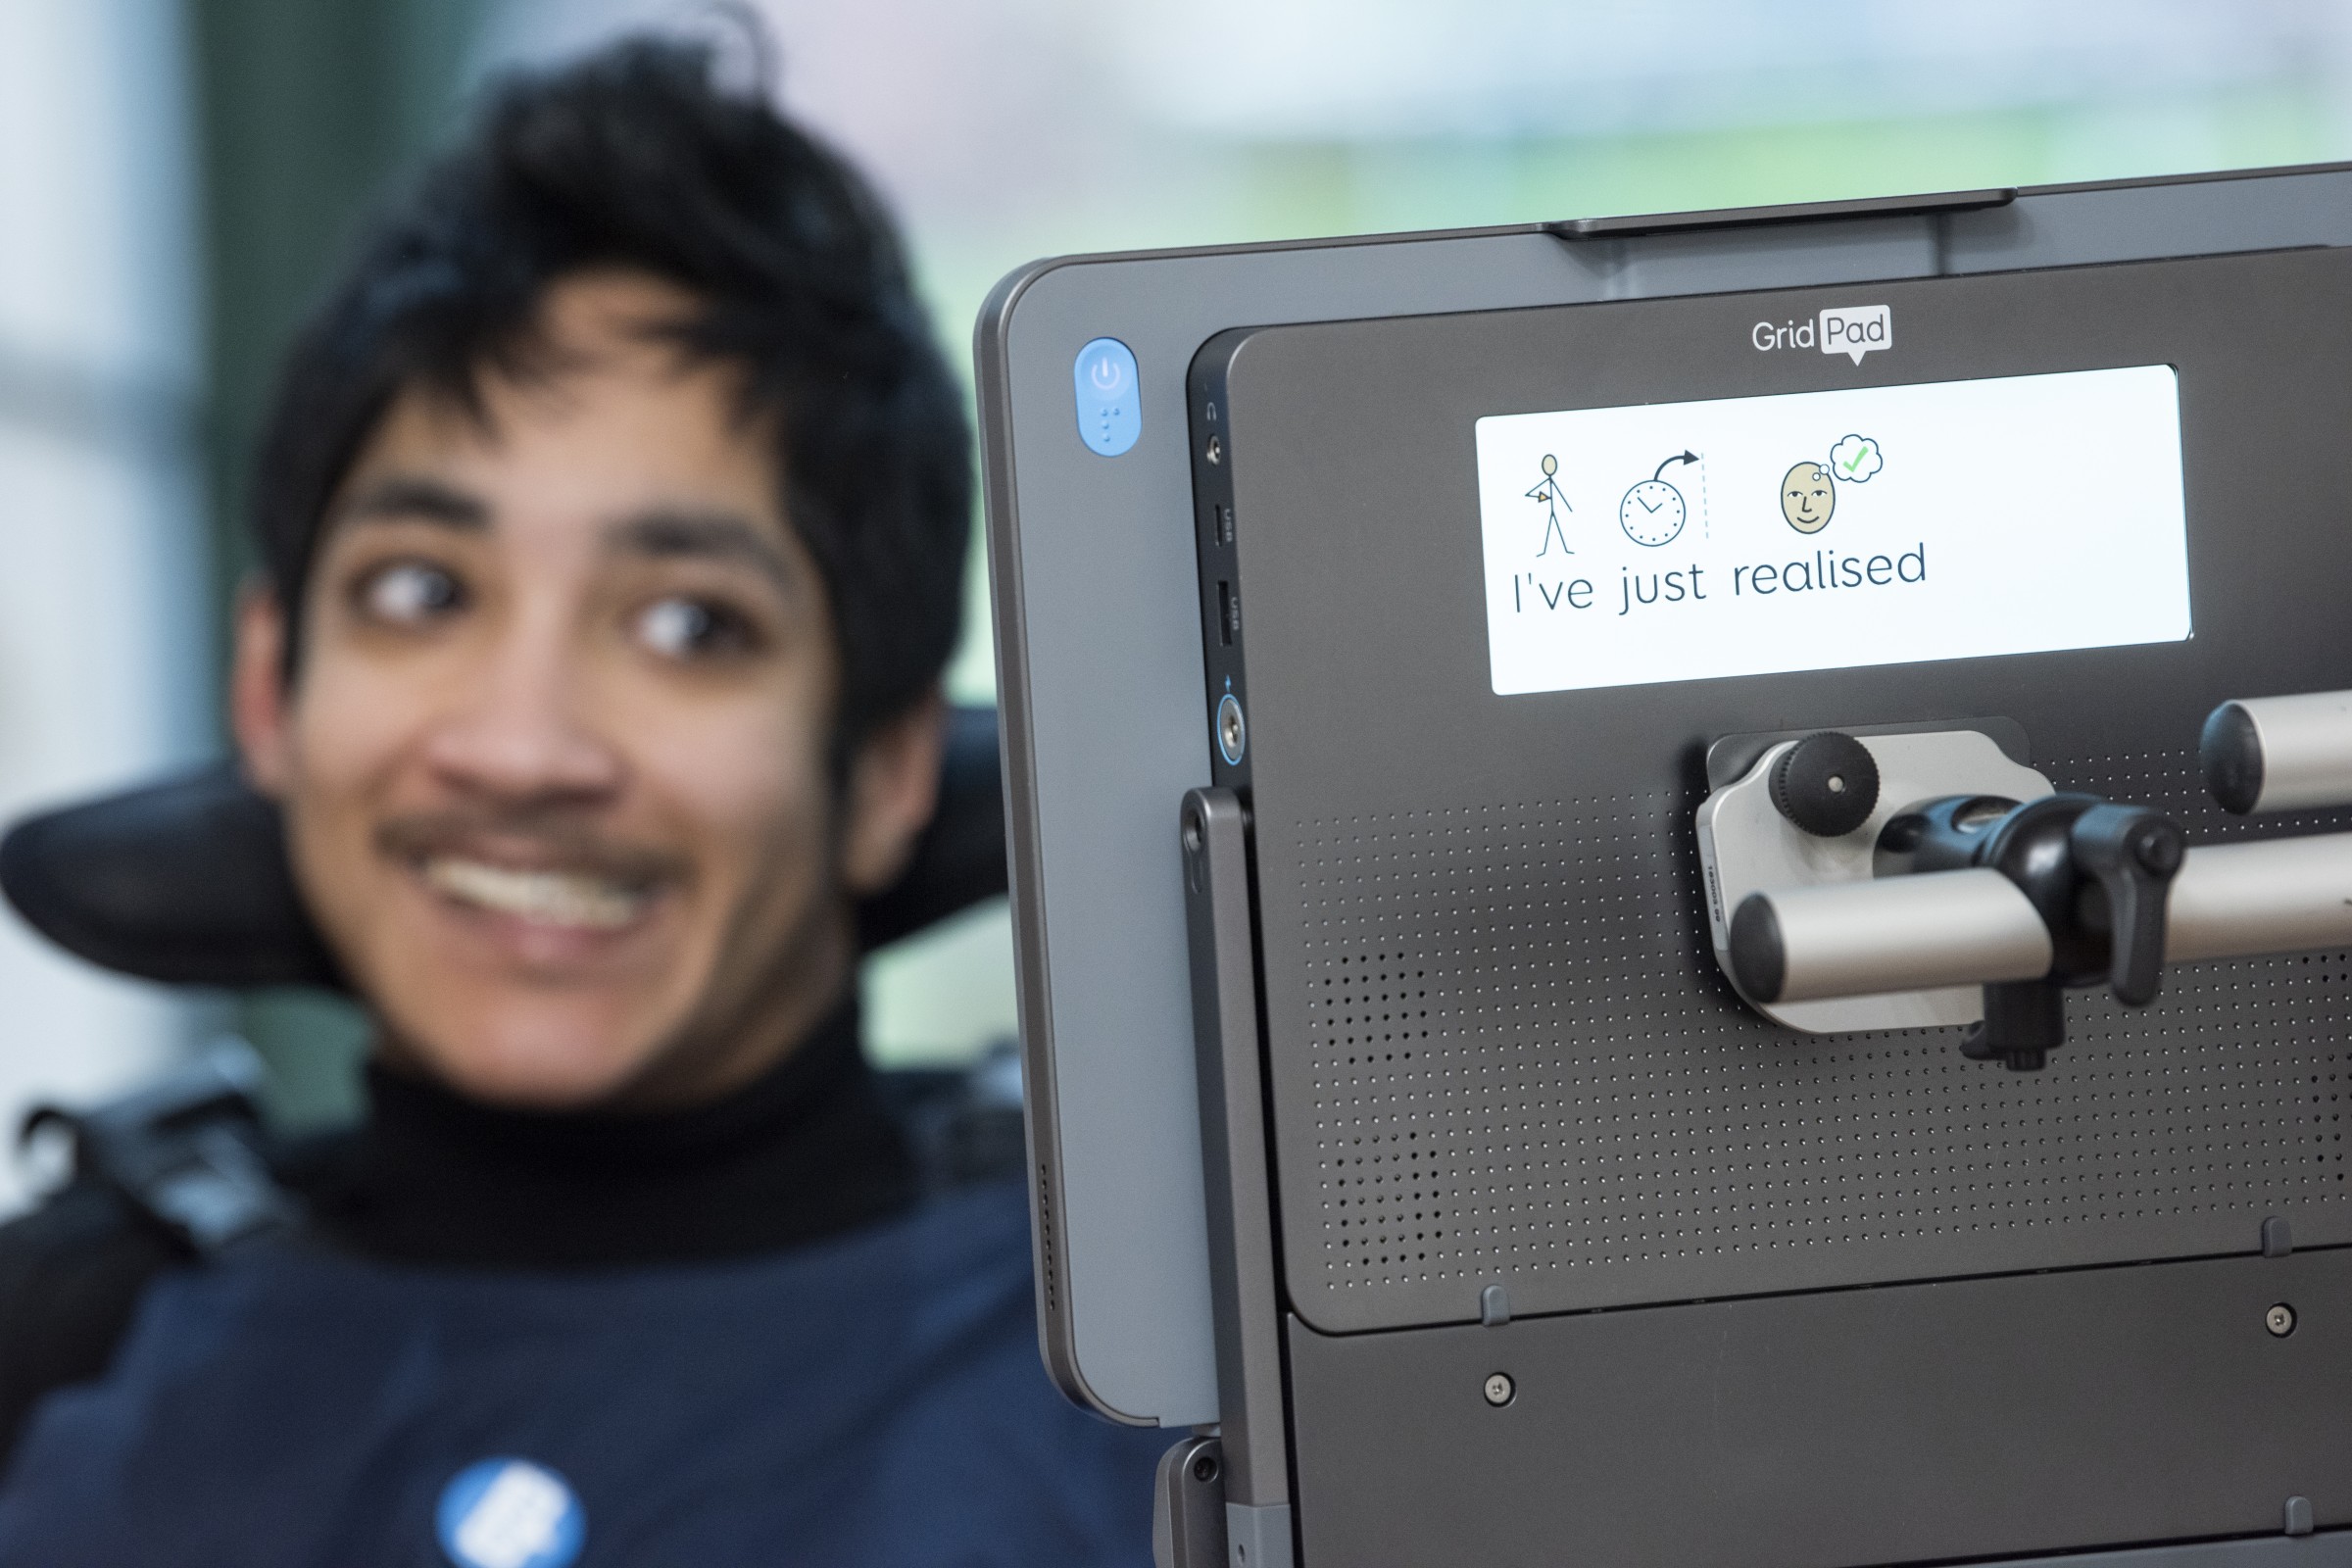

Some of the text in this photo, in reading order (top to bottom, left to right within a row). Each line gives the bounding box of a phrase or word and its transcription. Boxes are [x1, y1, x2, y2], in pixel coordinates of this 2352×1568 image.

[1752, 313, 1886, 352] Grid Pad
[1224, 508, 1234, 543] USB
[1514, 542, 1927, 616] I've just realised
[1231, 596, 1240, 631] USB
